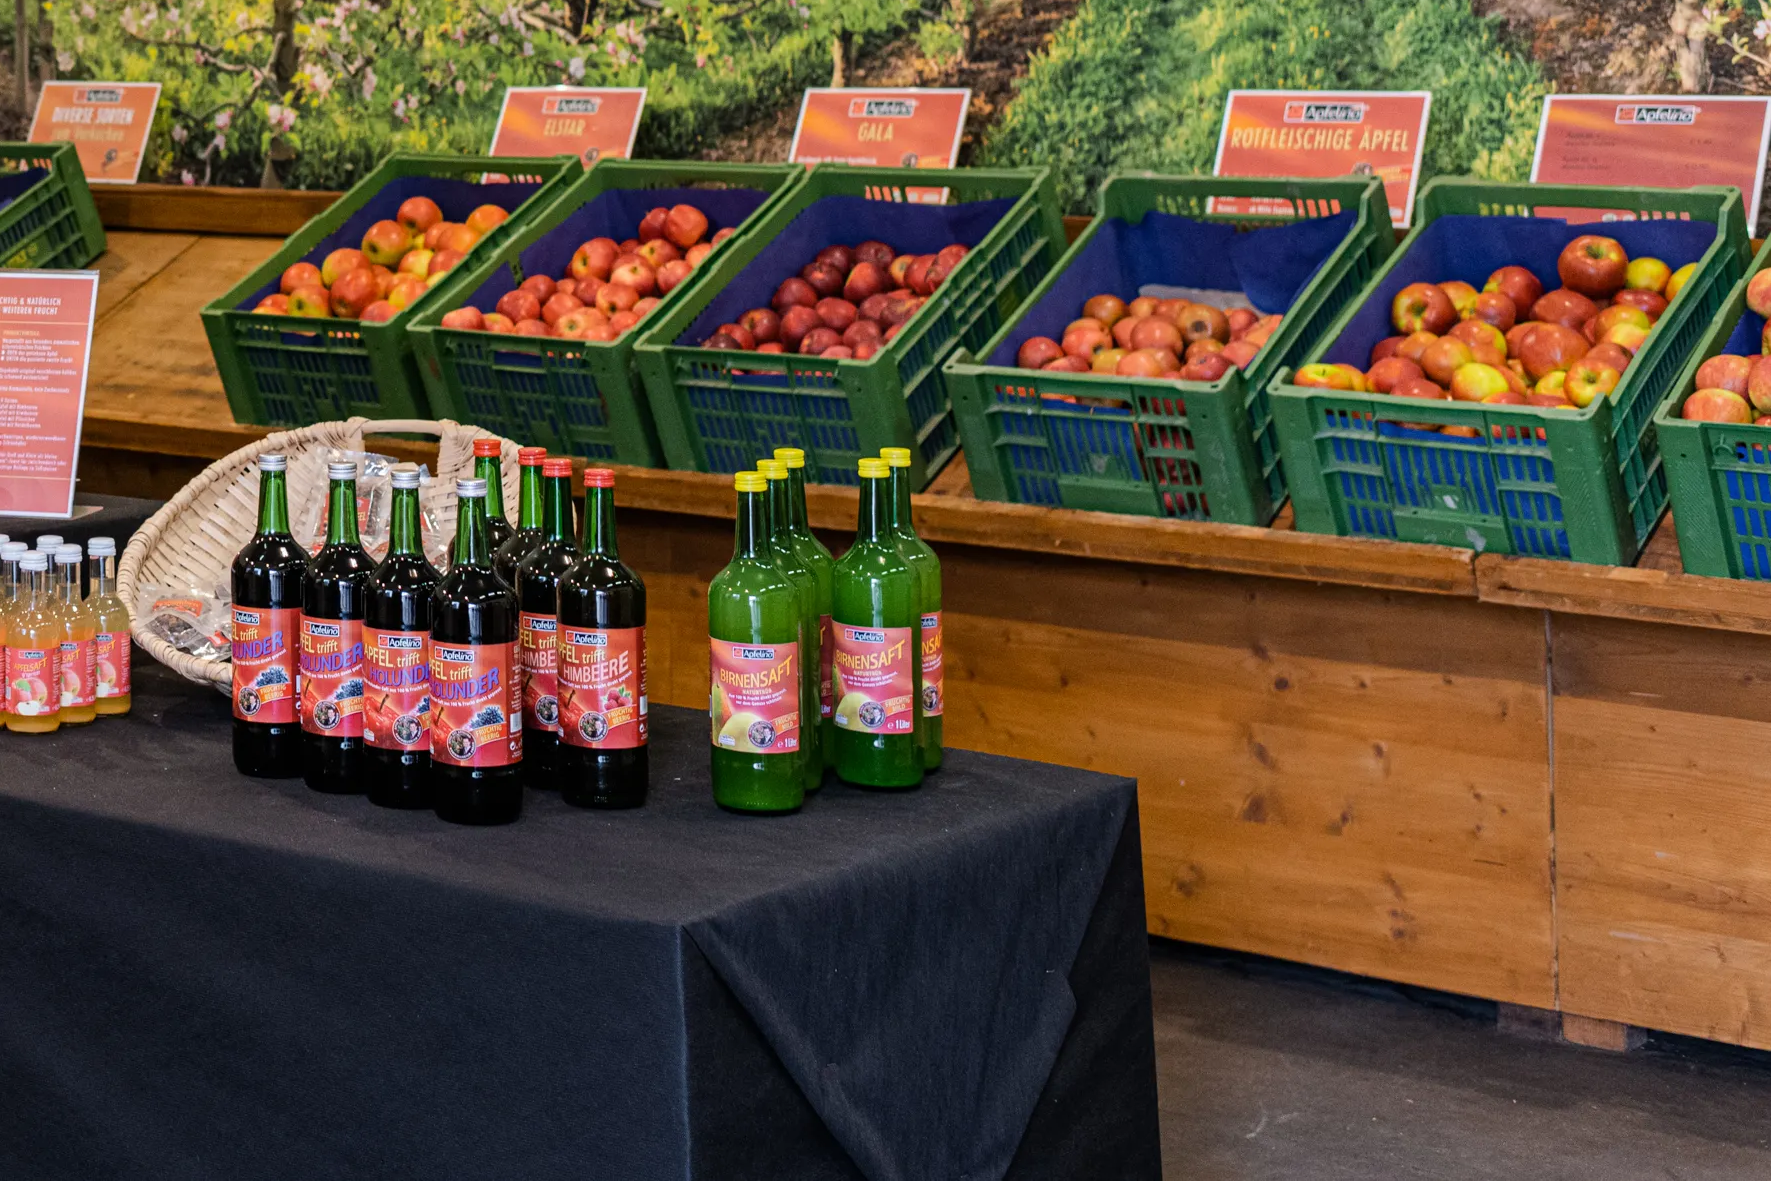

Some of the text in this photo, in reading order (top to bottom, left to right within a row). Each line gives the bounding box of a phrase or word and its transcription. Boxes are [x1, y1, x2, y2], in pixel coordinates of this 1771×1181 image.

[544, 119, 586, 136] ELSTAR
[858, 122, 894, 142] GALA
[1231, 124, 1409, 152] ROTFLEISCHIGE ÄPFEL
[26, 297, 61, 306] NATÜRLICH
[2, 306, 32, 315] WEITEREN
[34, 307, 58, 315] FRUCHT
[236, 611, 259, 624] Apfelino
[311, 623, 339, 636] Apfelino
[532, 620, 556, 631] Apfelin
[240, 628, 258, 641] trifft
[520, 629, 556, 649] FEL triff
[575, 634, 606, 645] Apfelino
[854, 631, 884, 642] Apfelino
[300, 632, 338, 653] PFEL trifft
[389, 637, 421, 649] Apfelino
[300, 641, 363, 671] OLUNDER
[364, 643, 420, 668] APFEL trifft
[443, 650, 473, 662] Apfelino
[521, 649, 556, 667] HIMBE
[558, 642, 606, 664] PFEL trifft
[743, 649, 773, 659] Apfelino
[835, 639, 905, 669] BIRNENSAFT
[14, 657, 48, 672] APFELSAFT
[430, 659, 473, 681] PFEL trifft
[564, 650, 628, 683] HIMBEERE
[370, 665, 430, 687] HOLUND
[720, 655, 793, 688] BIRNENSAFT
[885, 697, 910, 708] FRUCHTIG
[608, 707, 633, 719] FRUCHTIG
[775, 713, 796, 725] FRUCHTIG
[476, 725, 502, 737] FRUCHTIG
[900, 720, 910, 729] Liter
[480, 733, 500, 741] BEERIG
